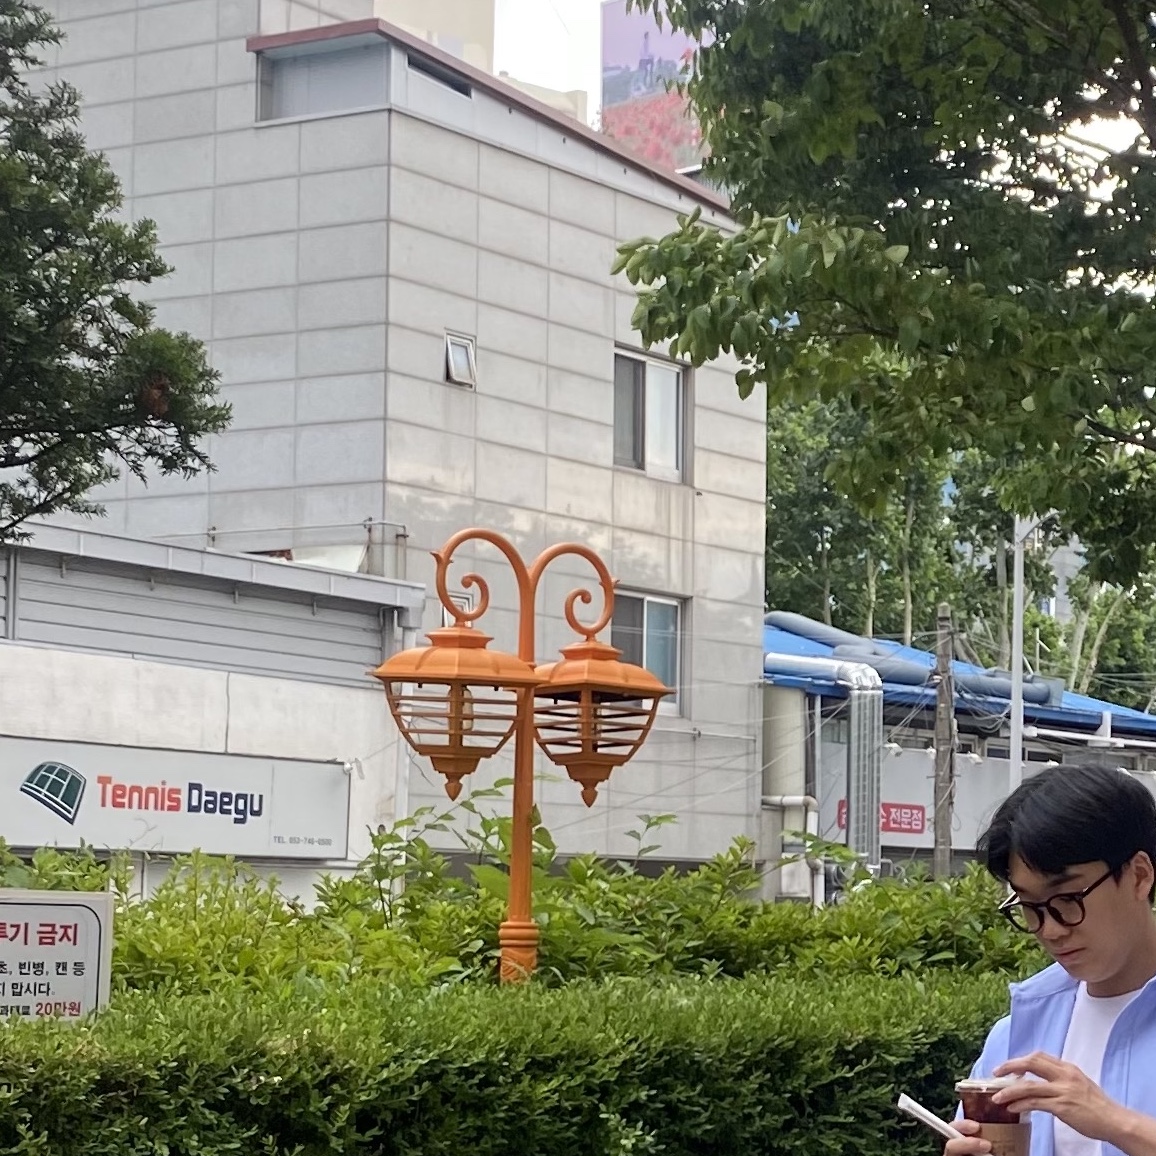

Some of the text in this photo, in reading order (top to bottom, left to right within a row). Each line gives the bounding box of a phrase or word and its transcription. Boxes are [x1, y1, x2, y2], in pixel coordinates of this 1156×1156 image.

[96, 775, 264, 824] Tennis Daegu
[889, 808, 922, 830] 전문점
[37, 923, 78, 946] 금지
[18, 961, 50, 976] 빈병,
[55, 961, 68, 976] 캔
[72, 961, 85, 976] 등
[35, 1001, 81, 1017] 20만원
